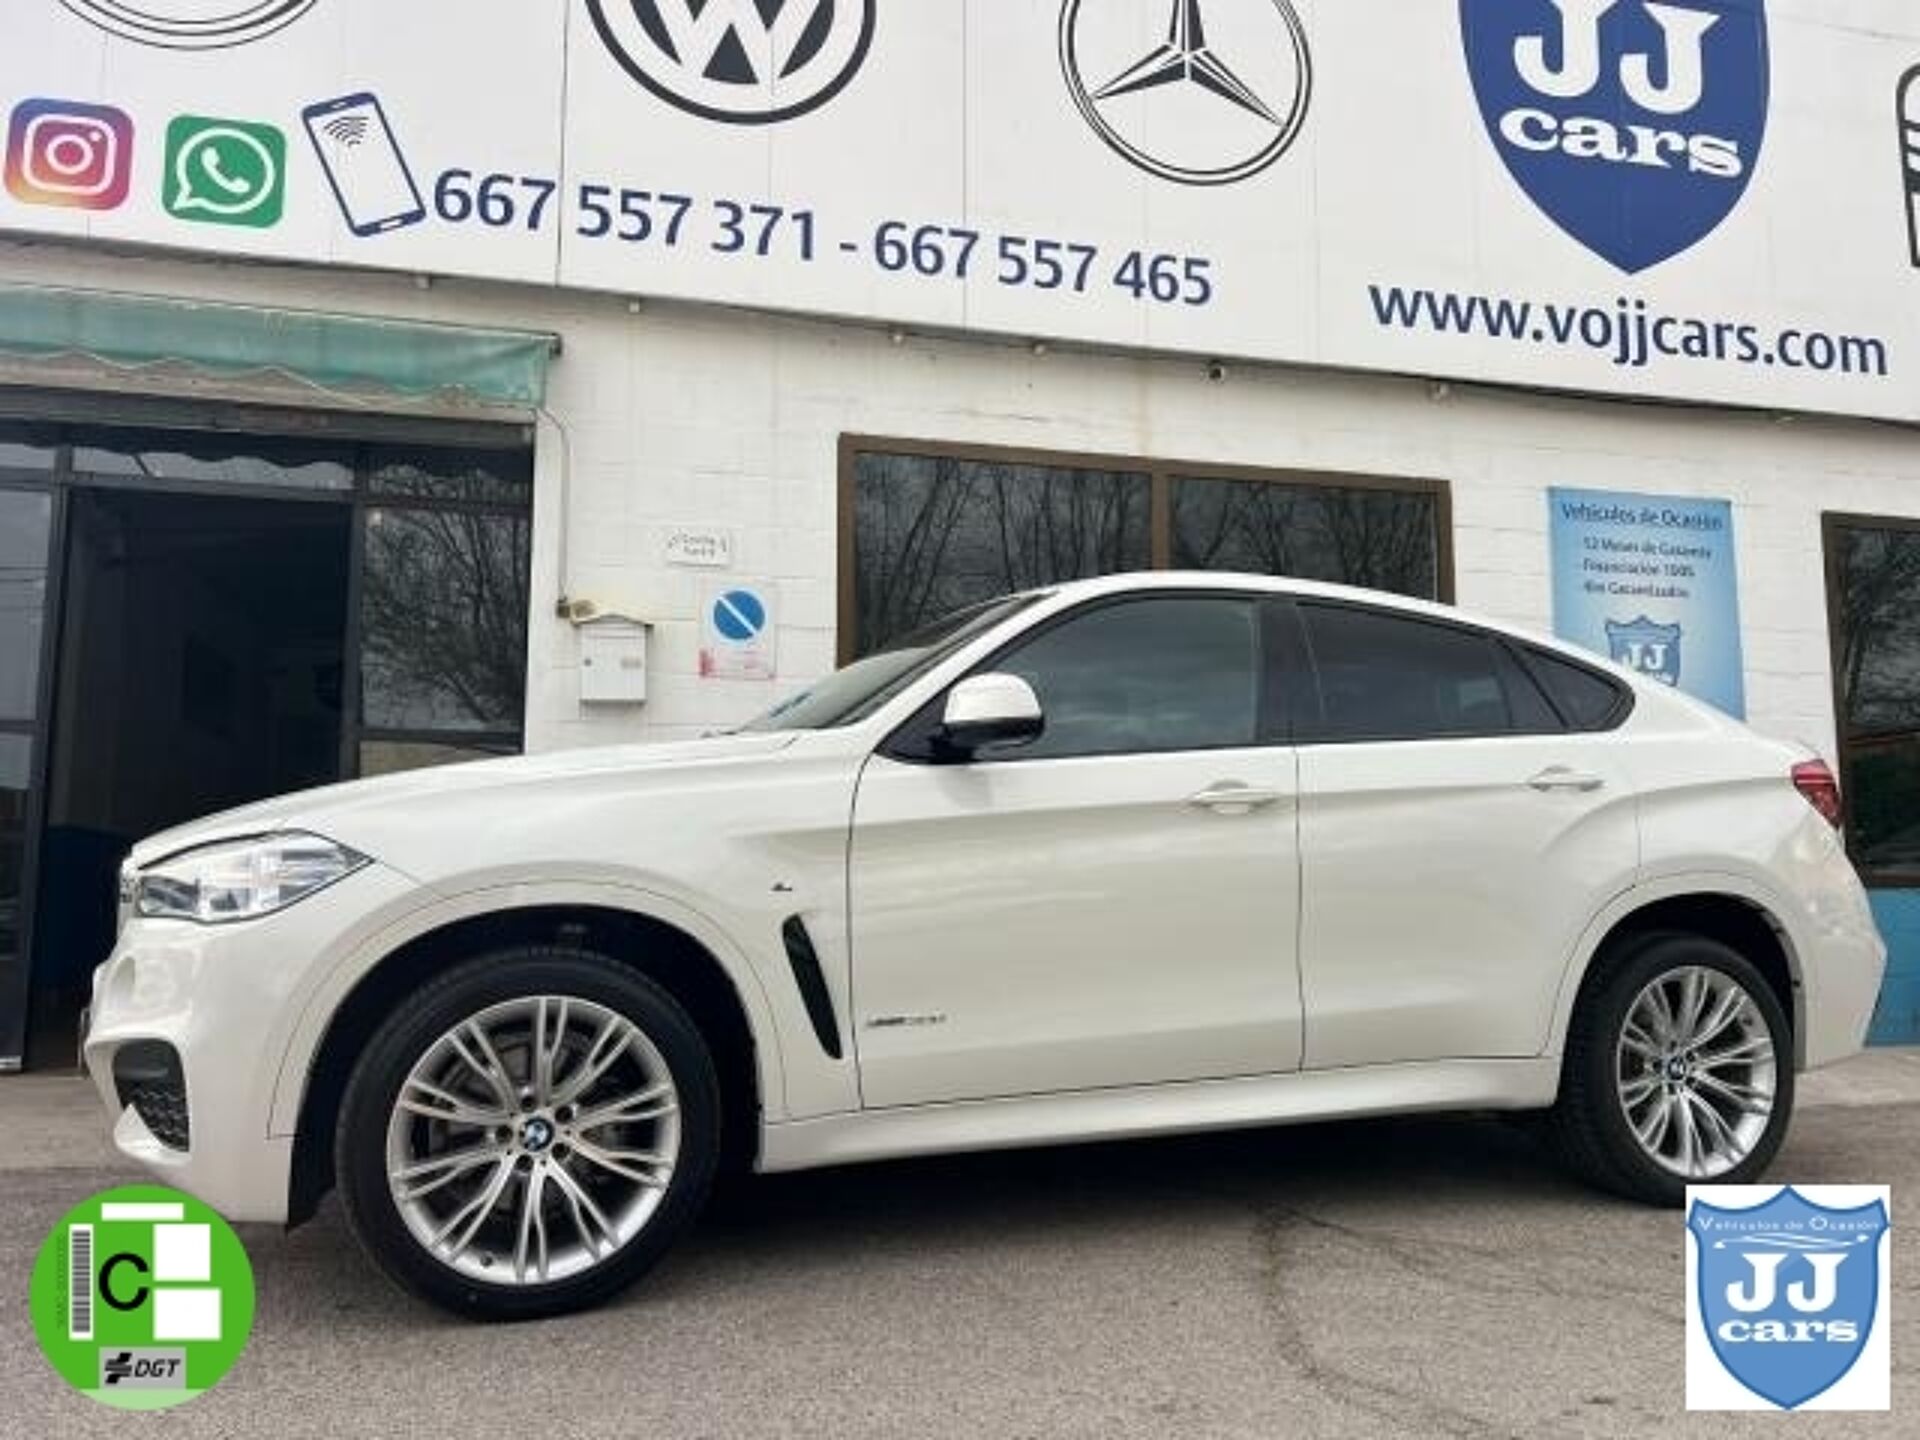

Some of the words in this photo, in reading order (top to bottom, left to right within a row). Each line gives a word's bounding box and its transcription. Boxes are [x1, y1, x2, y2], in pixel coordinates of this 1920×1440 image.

[1513, 0, 1720, 115] JJ
[1500, 107, 1743, 178] cars
[434, 169, 556, 230] 667
[577, 185, 692, 245] 557
[711, 200, 813, 261] 371
[874, 221, 980, 278] 667
[998, 236, 1098, 292] 557
[1112, 252, 1212, 305] 465
[1368, 284, 1888, 375] www.vojjcars.com
[1640, 508, 1660, 524] de
